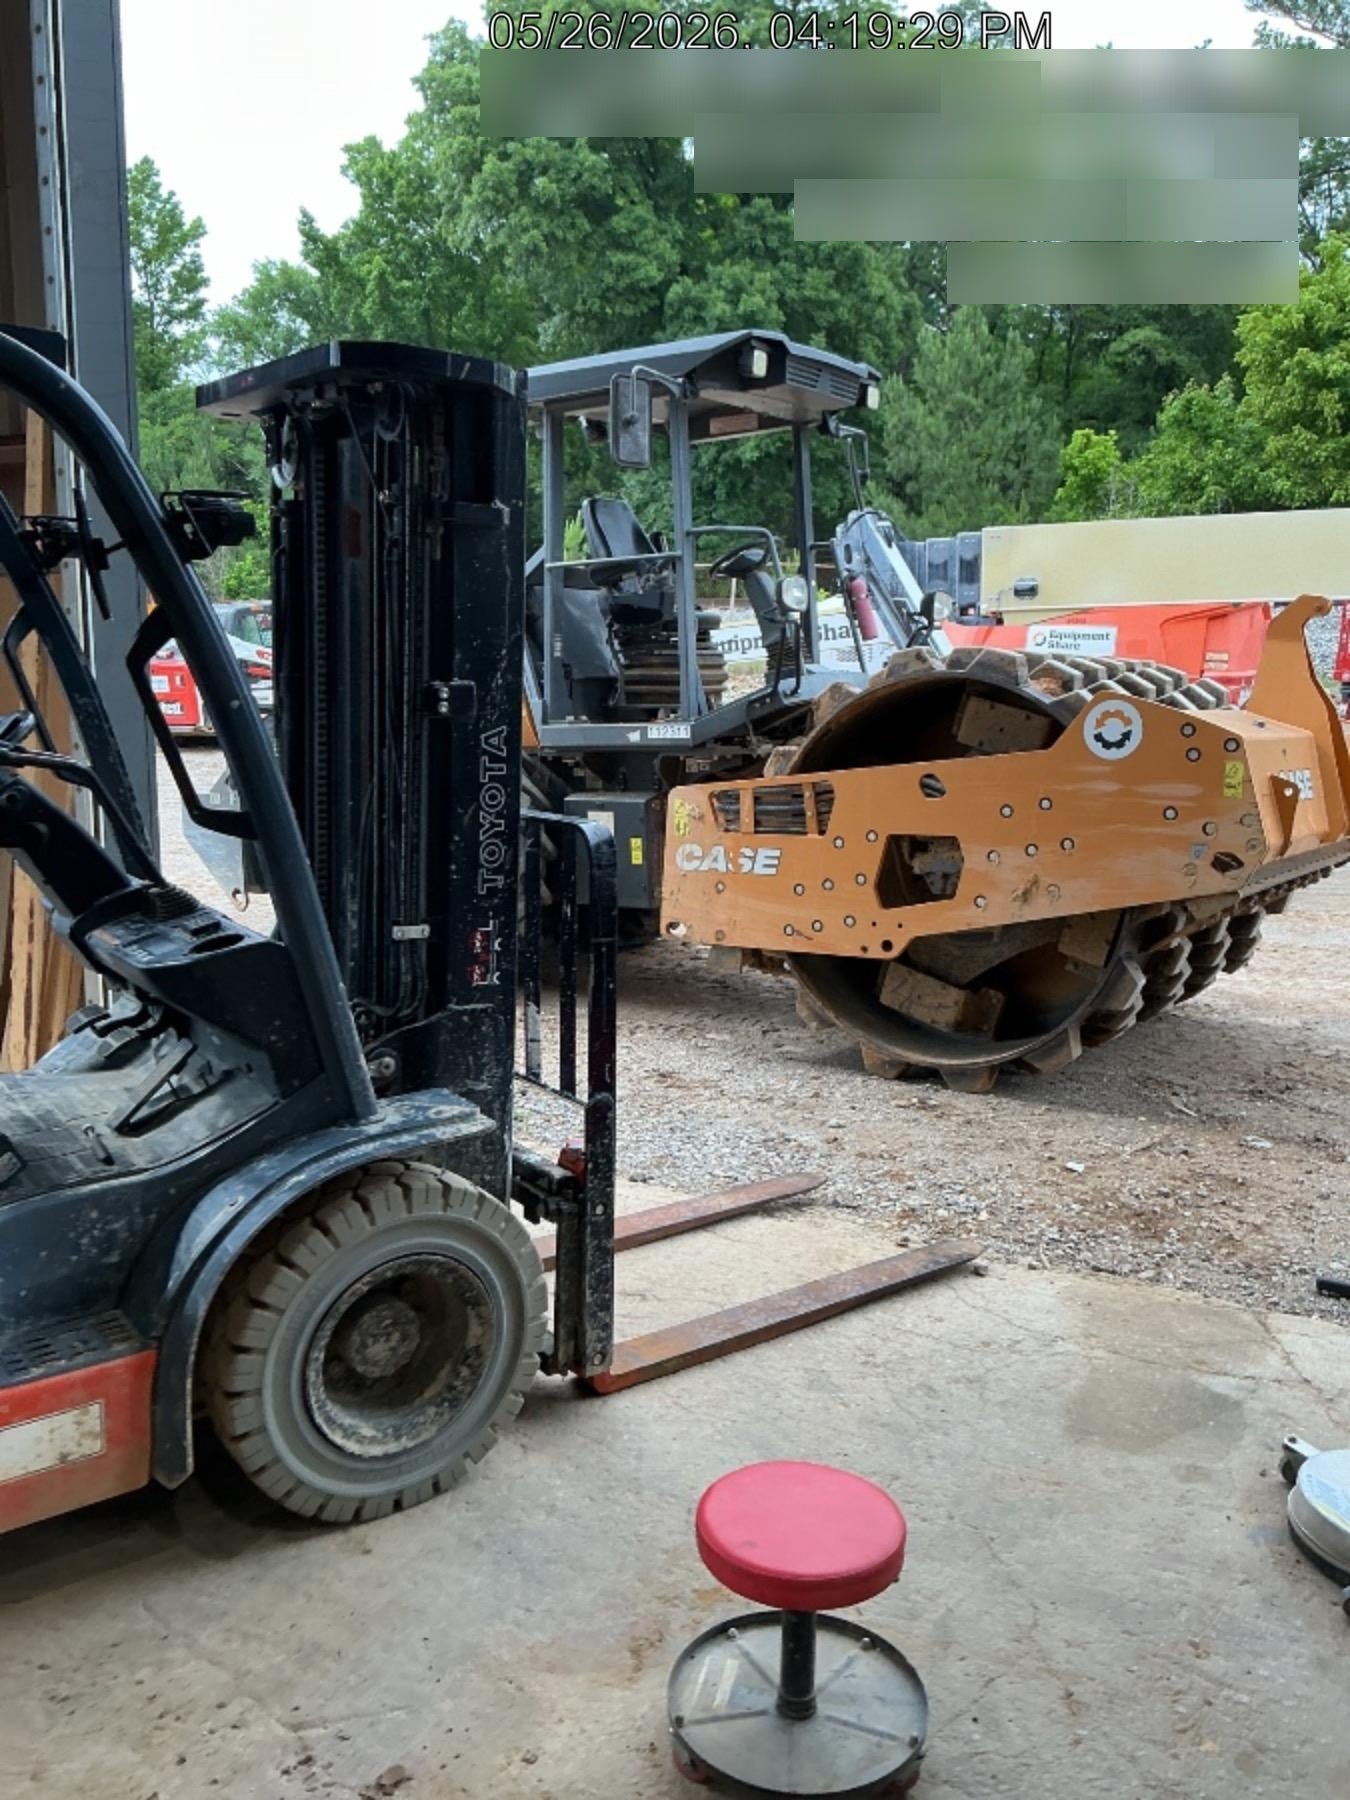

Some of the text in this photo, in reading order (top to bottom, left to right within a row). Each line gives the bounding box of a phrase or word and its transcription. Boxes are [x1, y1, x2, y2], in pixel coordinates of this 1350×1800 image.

[1048, 640, 1080, 650] Share
[1049, 629, 1111, 641] Equipment
[478, 725, 508, 895] TOYOTA
[675, 842, 782, 876] CASE
